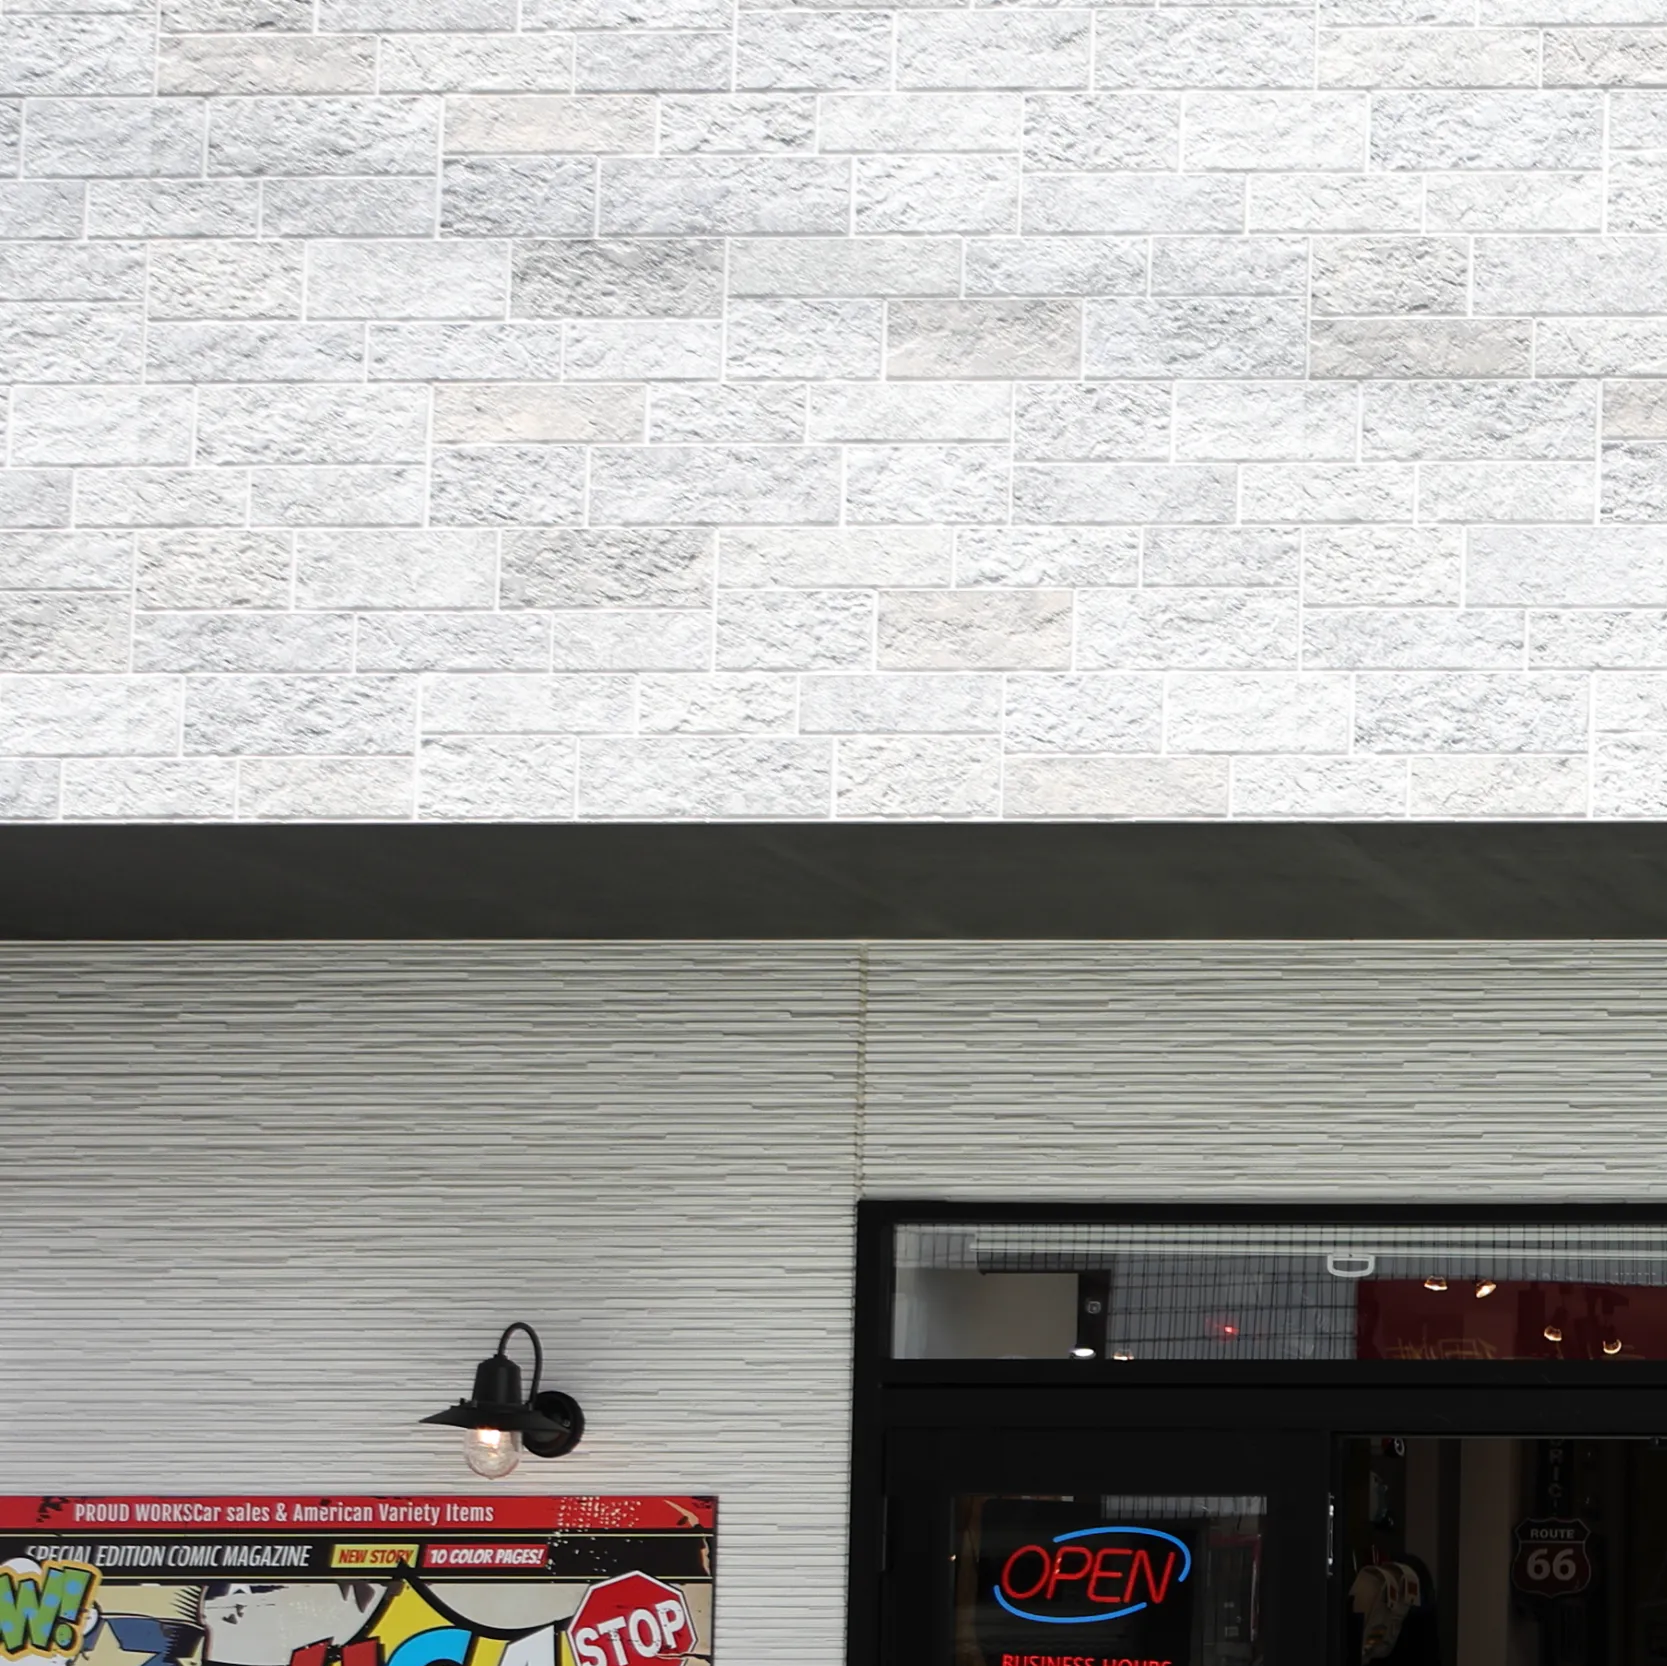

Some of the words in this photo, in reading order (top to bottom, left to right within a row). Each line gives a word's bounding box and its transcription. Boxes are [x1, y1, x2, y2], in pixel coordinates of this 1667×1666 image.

[75, 1503, 130, 1522] PROUD
[226, 1503, 270, 1522] sales
[275, 1504, 288, 1522] &
[293, 1503, 373, 1522] American
[379, 1503, 440, 1526] Variety
[446, 1503, 494, 1522] Items
[1529, 1527, 1576, 1541] ROUTE
[96, 1545, 167, 1567] EDITION
[168, 1545, 221, 1567] COMIC
[222, 1545, 313, 1567] MAGAZINE
[338, 1549, 368, 1564] NEW
[370, 1549, 414, 1564] STORY
[430, 1549, 447, 1564] 10
[449, 1549, 492, 1564] COLOR
[495, 1549, 544, 1565] PAGES!
[1526, 1547, 1578, 1582] 66
[1000, 1543, 1177, 1604] OPEN
